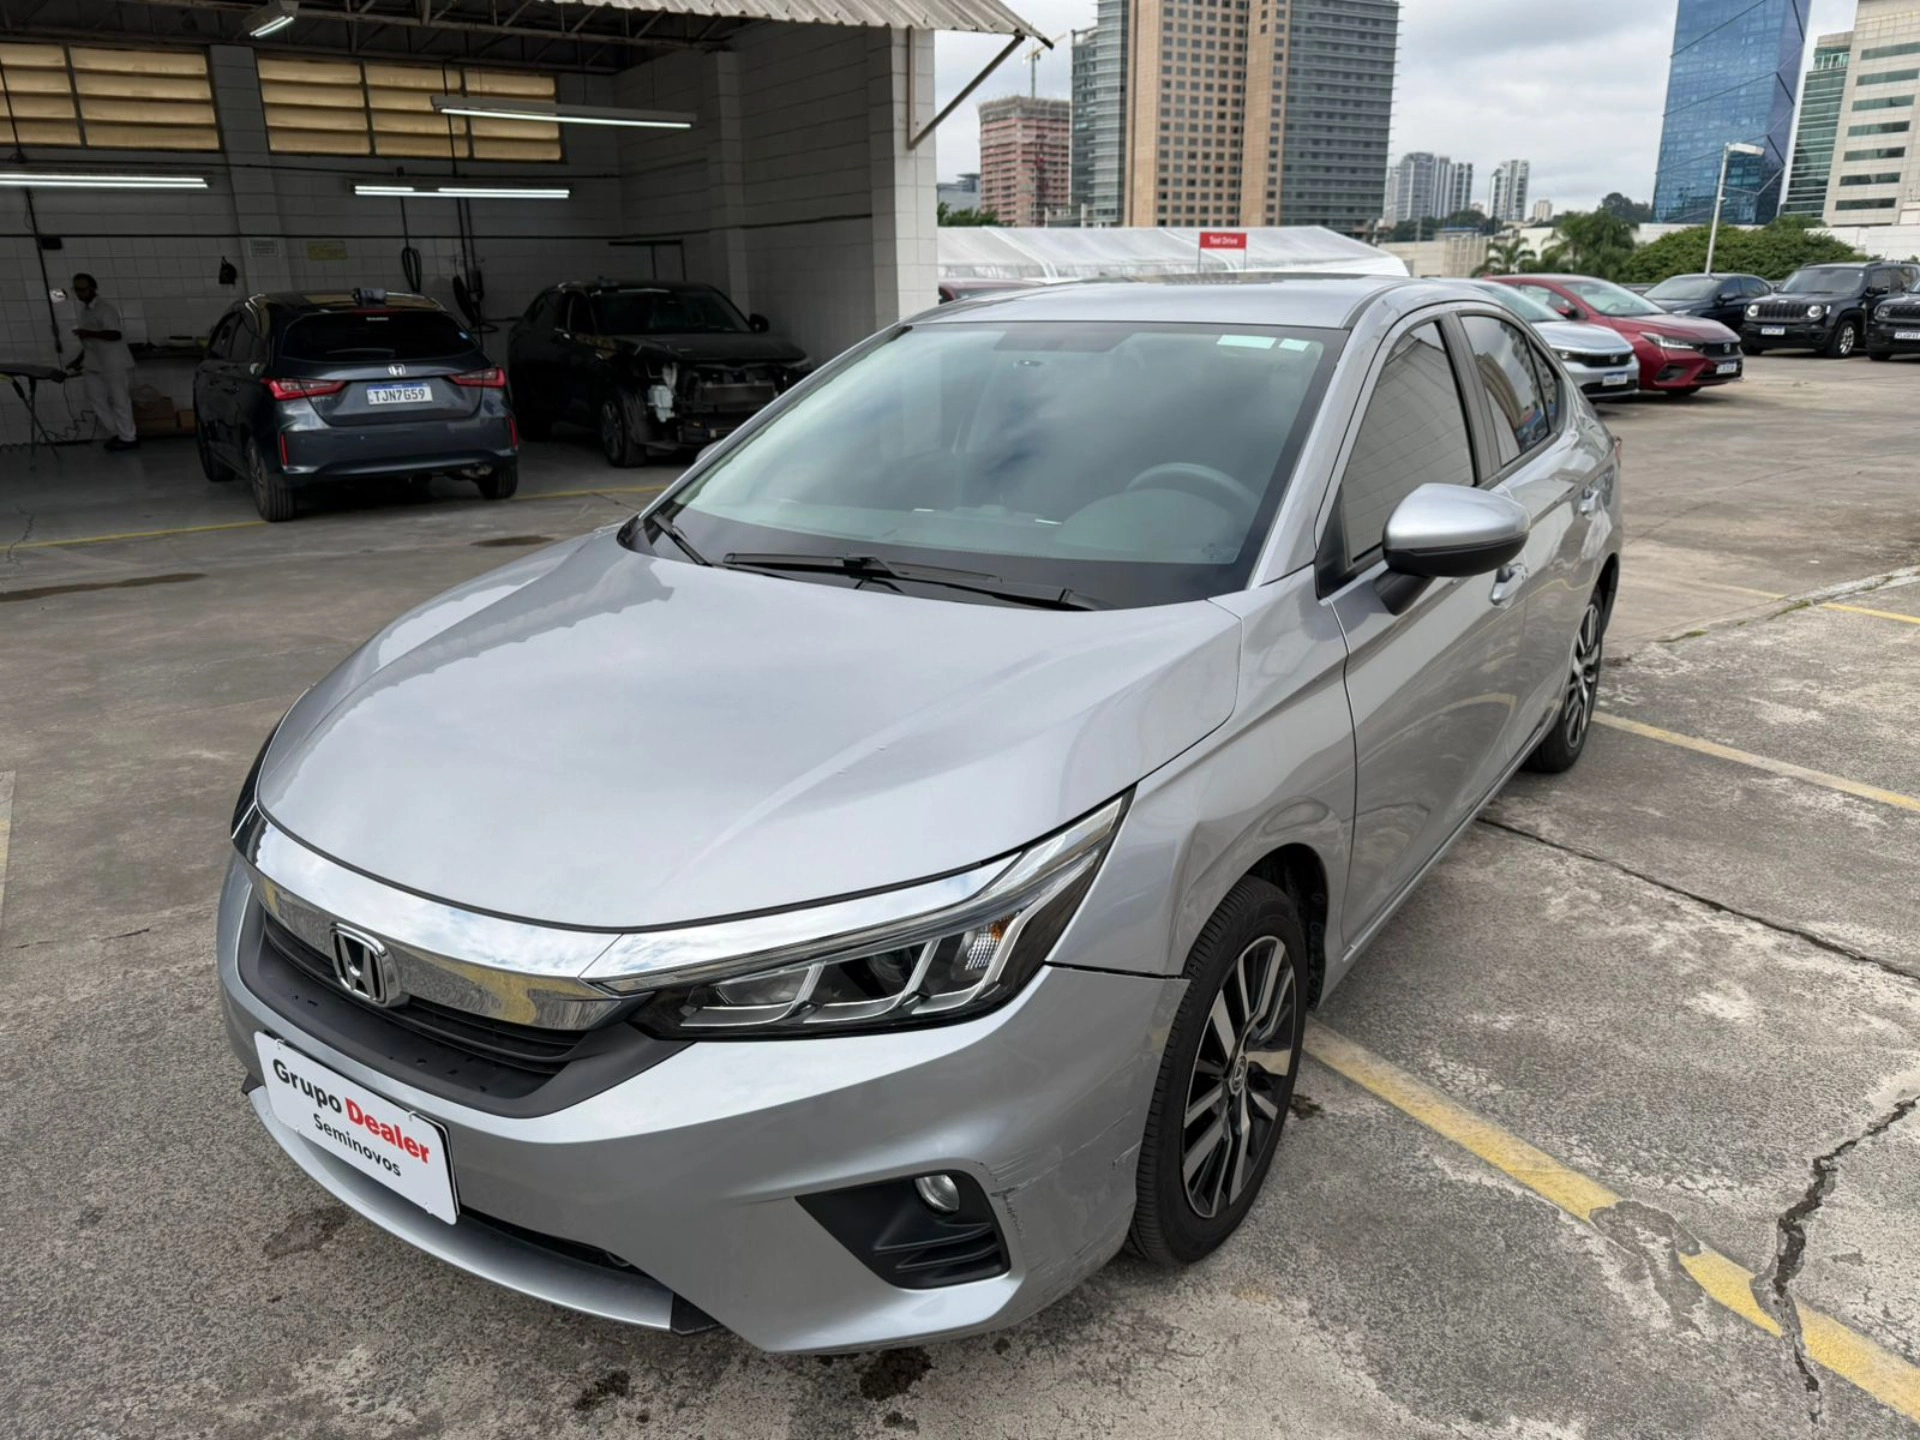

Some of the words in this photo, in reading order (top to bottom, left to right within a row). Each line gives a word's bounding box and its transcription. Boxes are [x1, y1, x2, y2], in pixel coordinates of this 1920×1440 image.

[1209, 235, 1220, 244] Test
[1221, 235, 1238, 244] Drive
[373, 388, 425, 402] TJN7G59
[273, 1059, 342, 1113] Grupo
[345, 1097, 430, 1164] Dealer
[313, 1113, 401, 1177] Seminovos
